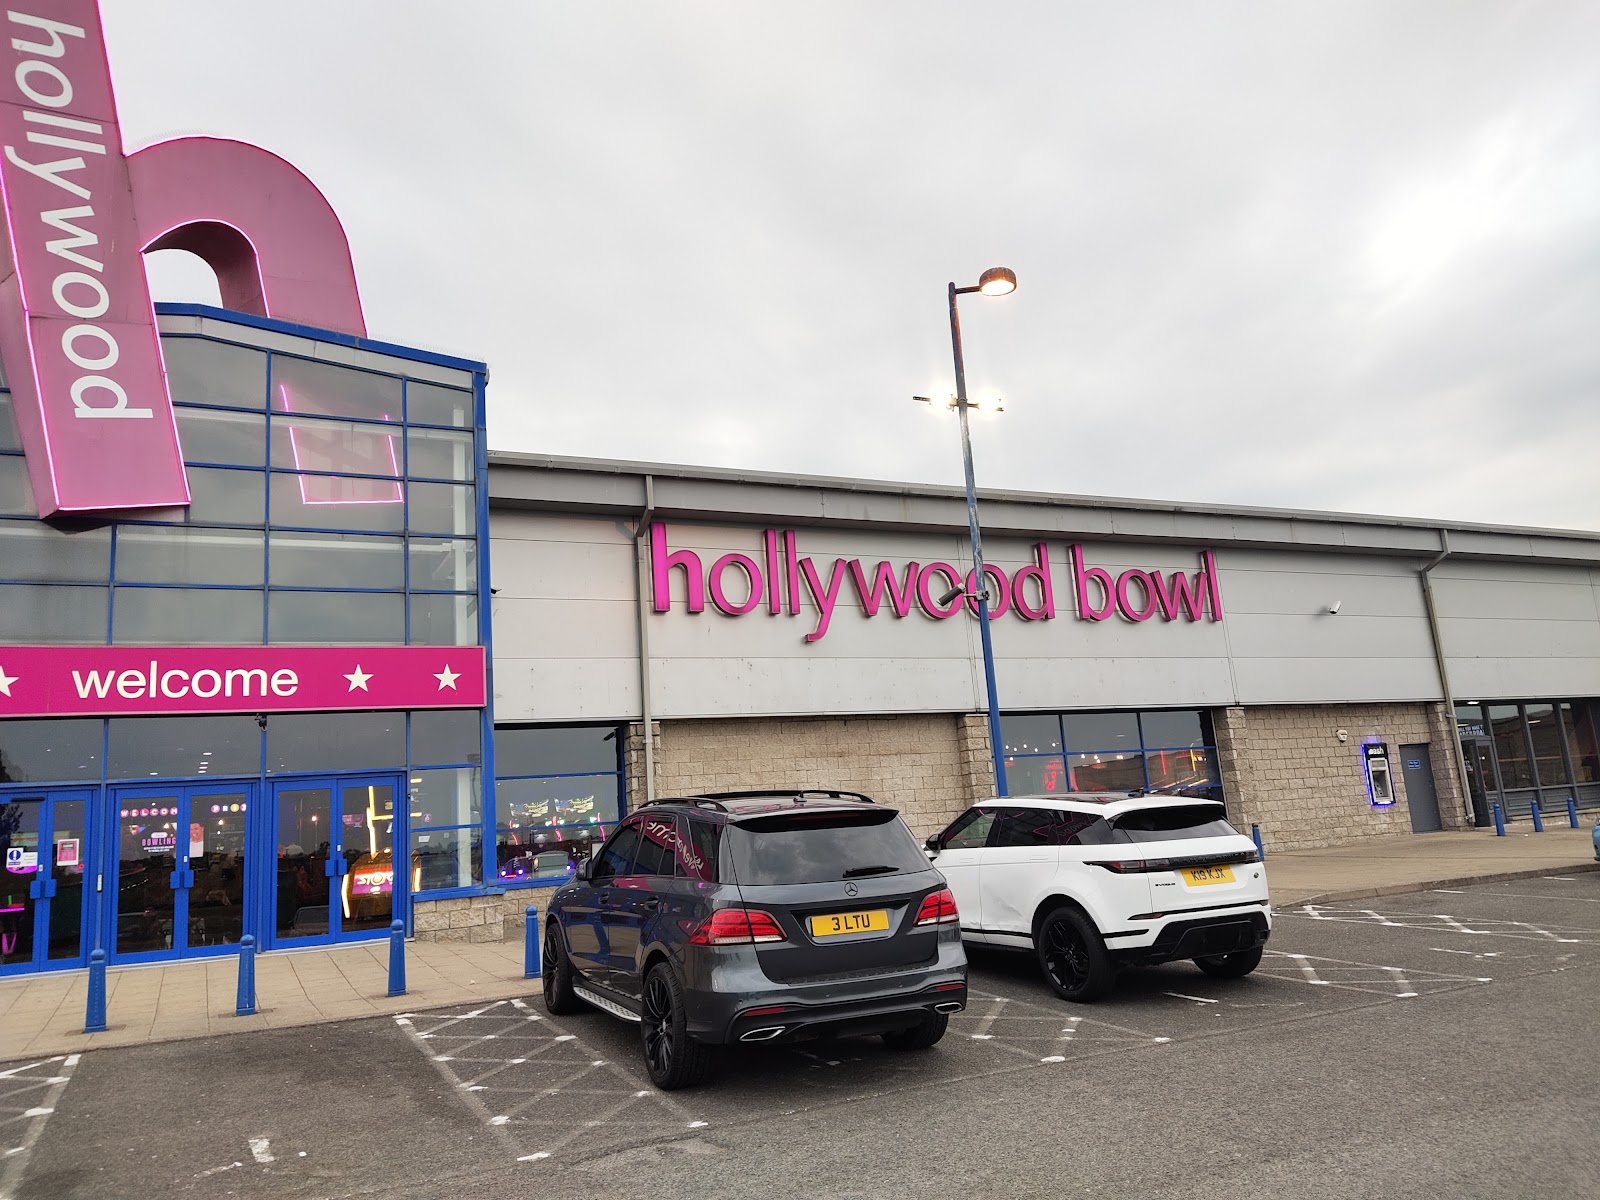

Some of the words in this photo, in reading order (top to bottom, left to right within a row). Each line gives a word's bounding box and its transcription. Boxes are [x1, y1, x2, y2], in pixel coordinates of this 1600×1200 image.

[4, 11, 154, 420] hollywood
[650, 521, 1055, 643] hollywood
[1070, 543, 1222, 622] bowl
[71, 660, 299, 699] welcome
[142, 837, 176, 847] BOWLING
[831, 916, 841, 931] 3
[844, 914, 870, 930] LTU
